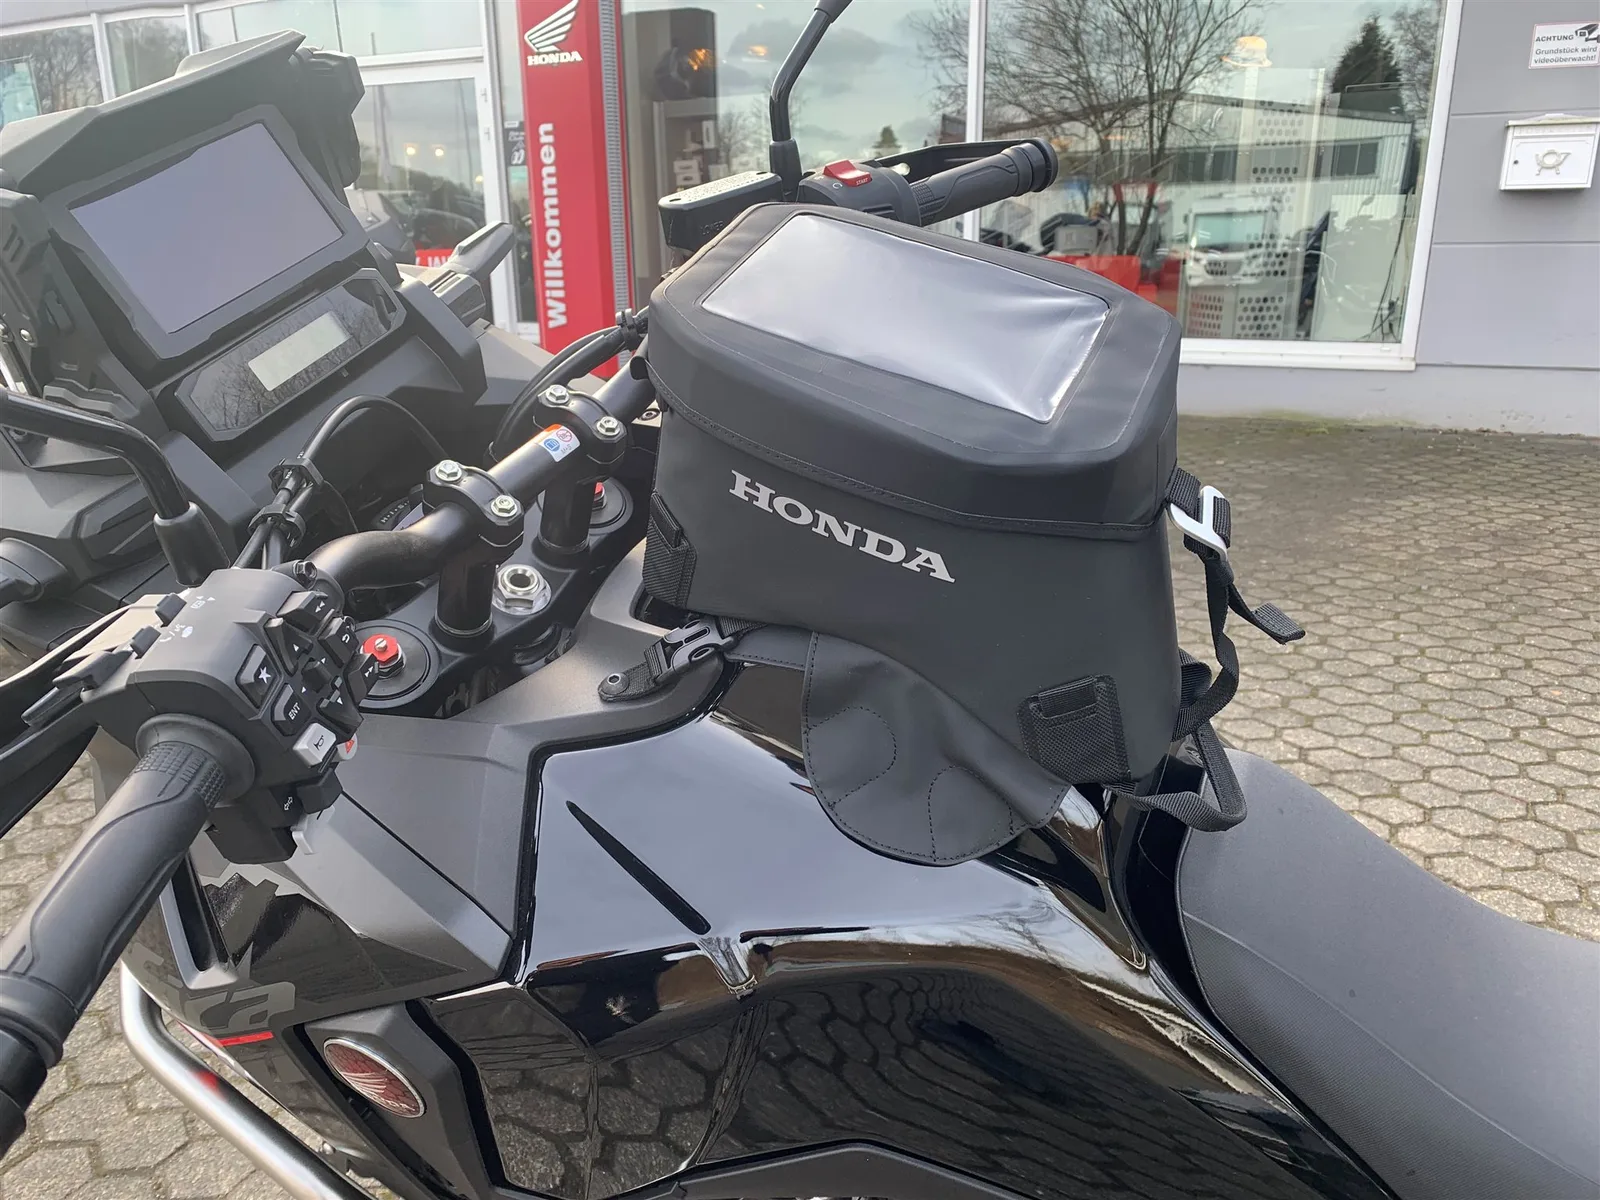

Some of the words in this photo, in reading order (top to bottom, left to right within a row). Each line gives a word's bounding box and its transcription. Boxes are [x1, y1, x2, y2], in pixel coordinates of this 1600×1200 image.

[1535, 34, 1574, 42] ACHTUNG
[1535, 46, 1579, 55] Grundstück
[526, 51, 583, 66] HONDA
[1533, 54, 1596, 64] videoüberwacht!
[538, 122, 567, 328] Willkommen
[729, 469, 955, 583] HONDA
[288, 702, 300, 720] ENT
